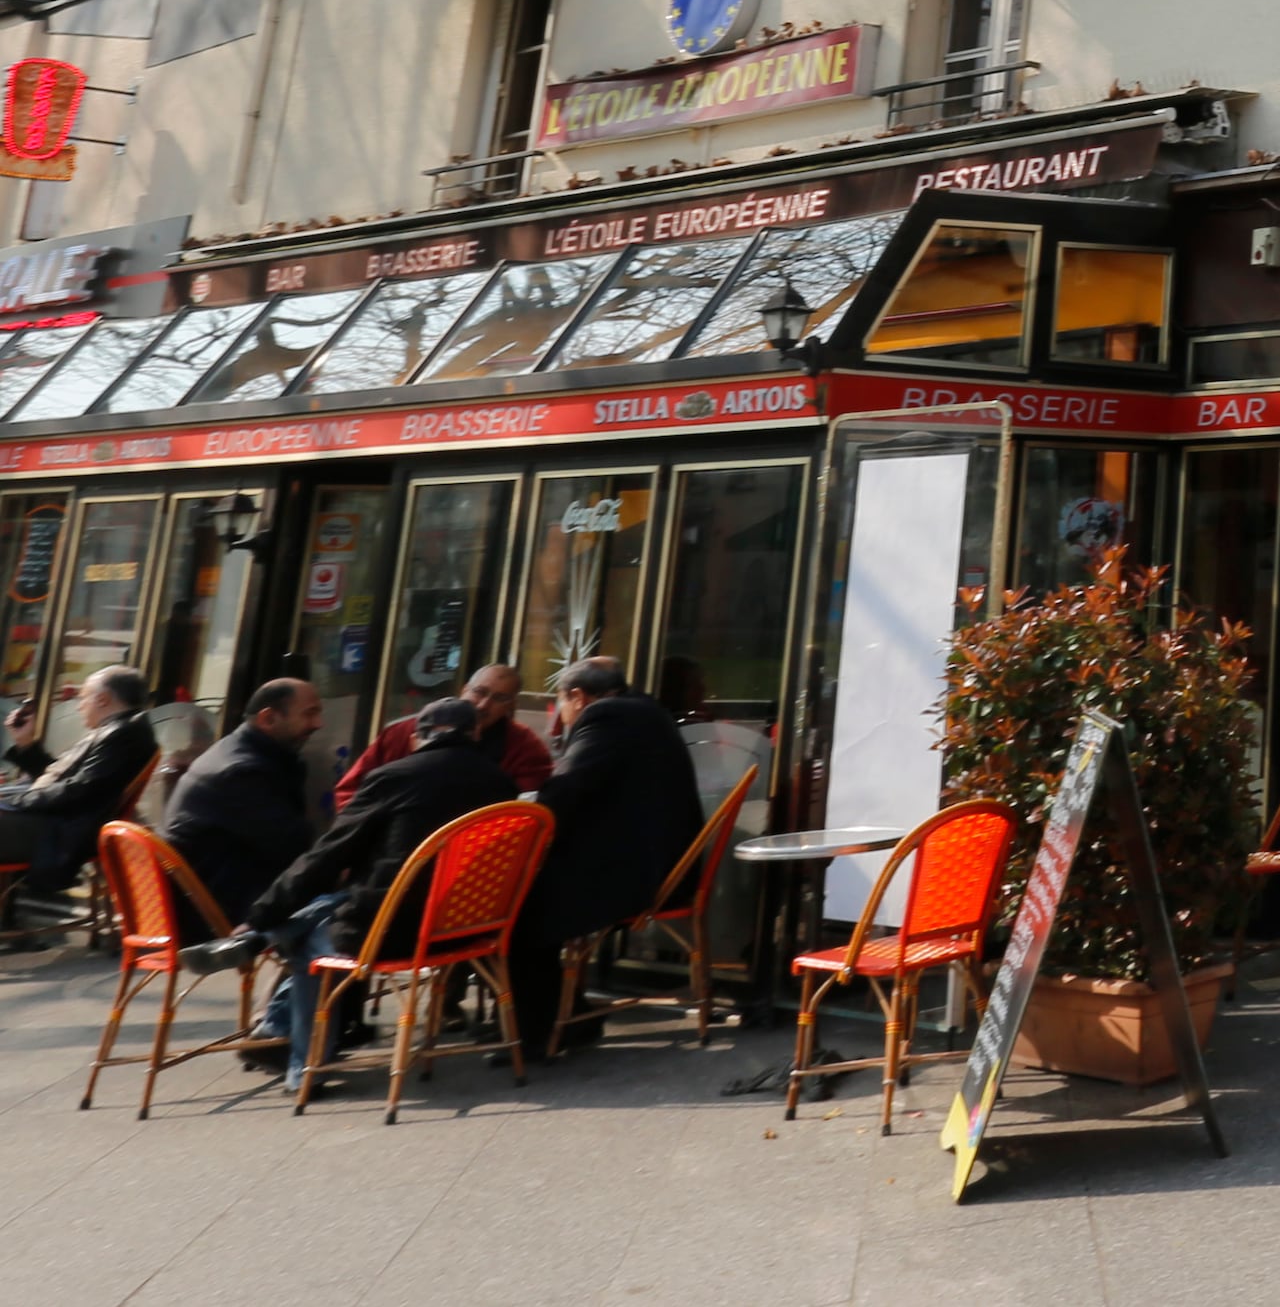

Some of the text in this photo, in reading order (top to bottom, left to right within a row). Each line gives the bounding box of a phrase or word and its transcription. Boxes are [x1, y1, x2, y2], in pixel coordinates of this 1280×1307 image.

[663, 42, 851, 116] EUROPÉENNE
[912, 146, 1108, 204] RESTAURANT
[266, 264, 305, 292] BAR
[545, 217, 647, 256] L'ÉTOILE
[652, 190, 830, 242] EUROPÉENNE
[594, 395, 670, 424] STELLA
[720, 384, 807, 415] ARTOIS
[901, 386, 1120, 426] BRASSERIE
[1197, 397, 1267, 426] BAR
